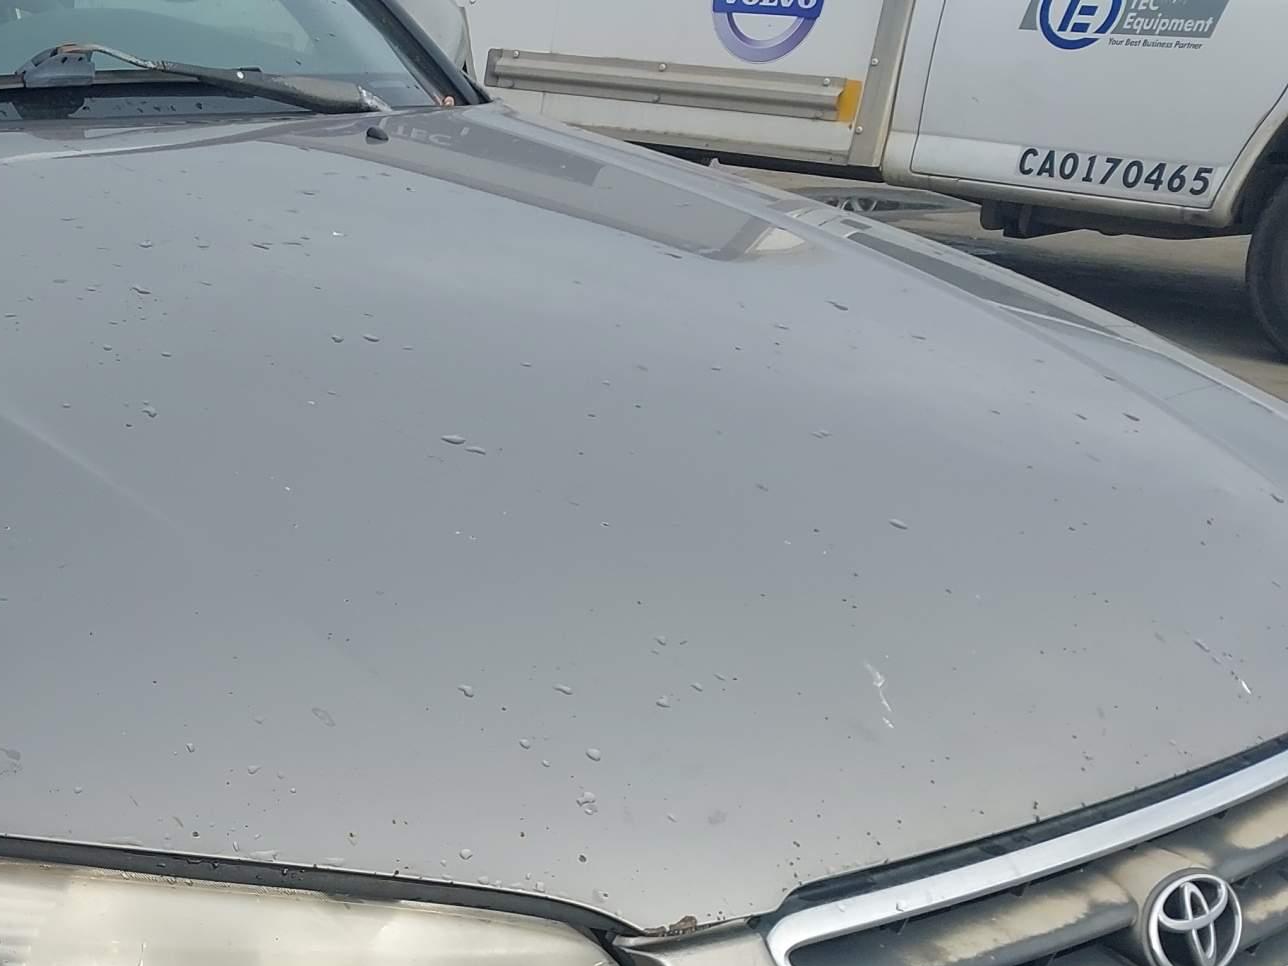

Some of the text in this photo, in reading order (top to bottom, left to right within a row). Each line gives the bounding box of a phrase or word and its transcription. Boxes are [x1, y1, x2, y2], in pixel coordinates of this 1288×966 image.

[725, 0, 817, 9] LVO
[1130, 0, 1160, 10] TEC
[1123, 13, 1213, 34] Equipment
[1108, 38, 1203, 50] Your Best Business Partner
[1019, 148, 1213, 196] CA0170465
